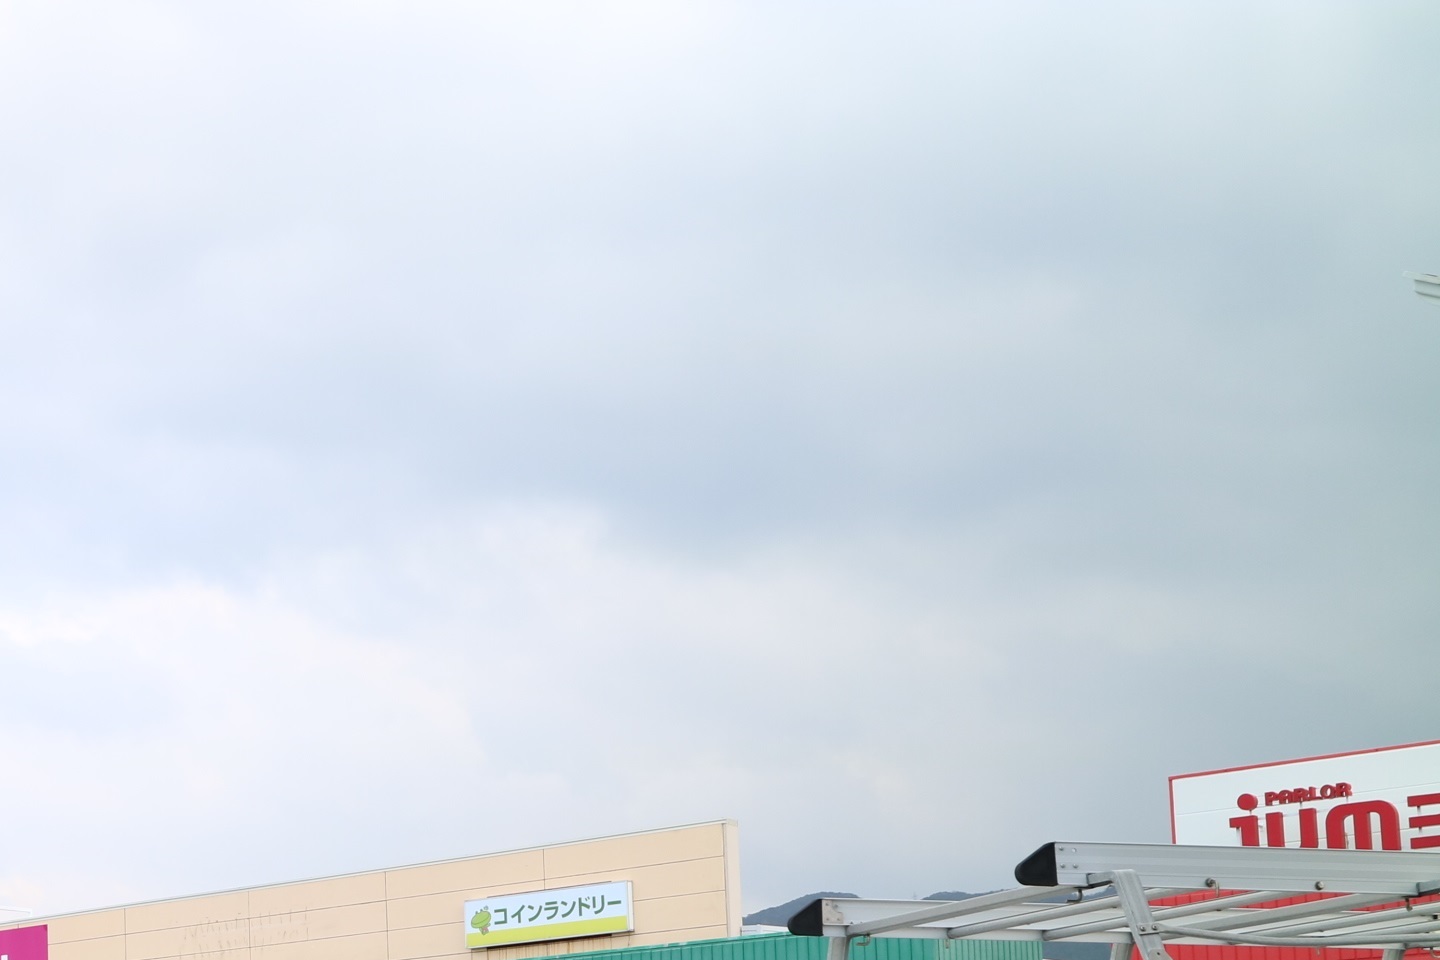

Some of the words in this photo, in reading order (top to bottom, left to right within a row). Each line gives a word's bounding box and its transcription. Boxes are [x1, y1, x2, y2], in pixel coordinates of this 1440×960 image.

[1265, 782, 1353, 806] PARLOR
[494, 894, 622, 926] コインランドリー
